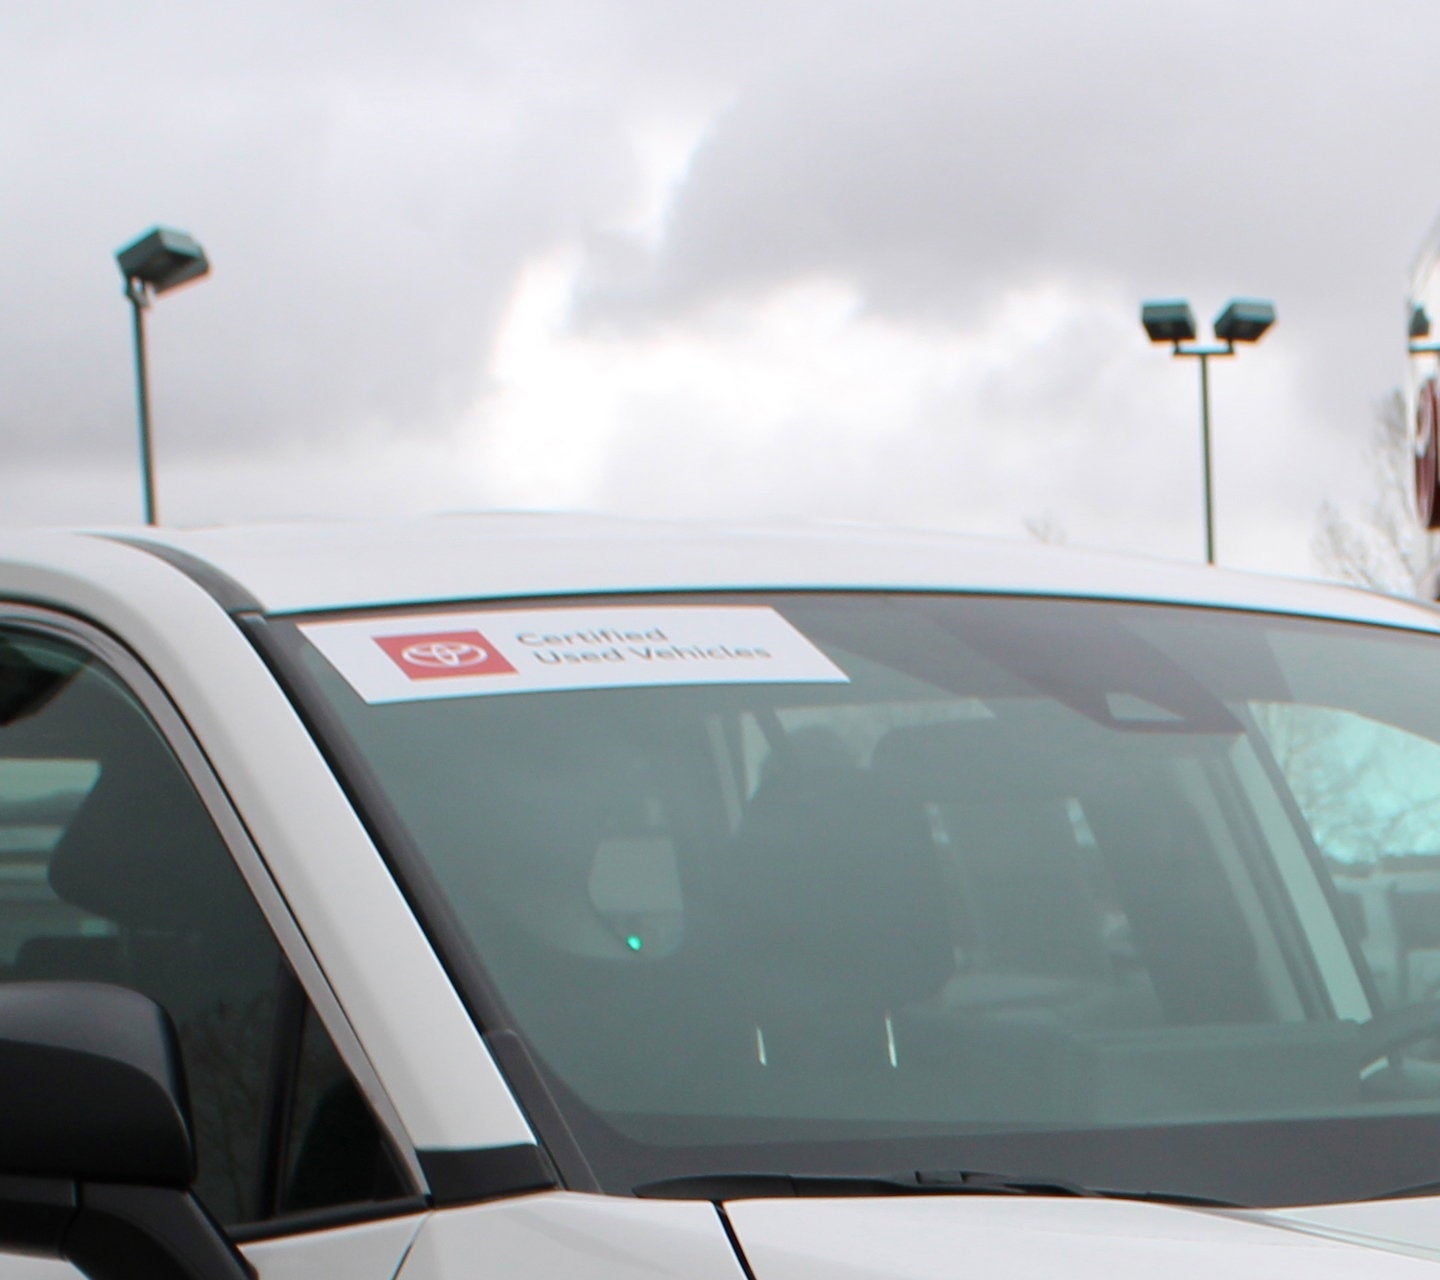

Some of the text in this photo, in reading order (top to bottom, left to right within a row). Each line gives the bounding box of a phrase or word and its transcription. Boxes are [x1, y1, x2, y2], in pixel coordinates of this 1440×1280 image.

[517, 628, 668, 647] Certified
[533, 644, 772, 666] Used Vehicles
